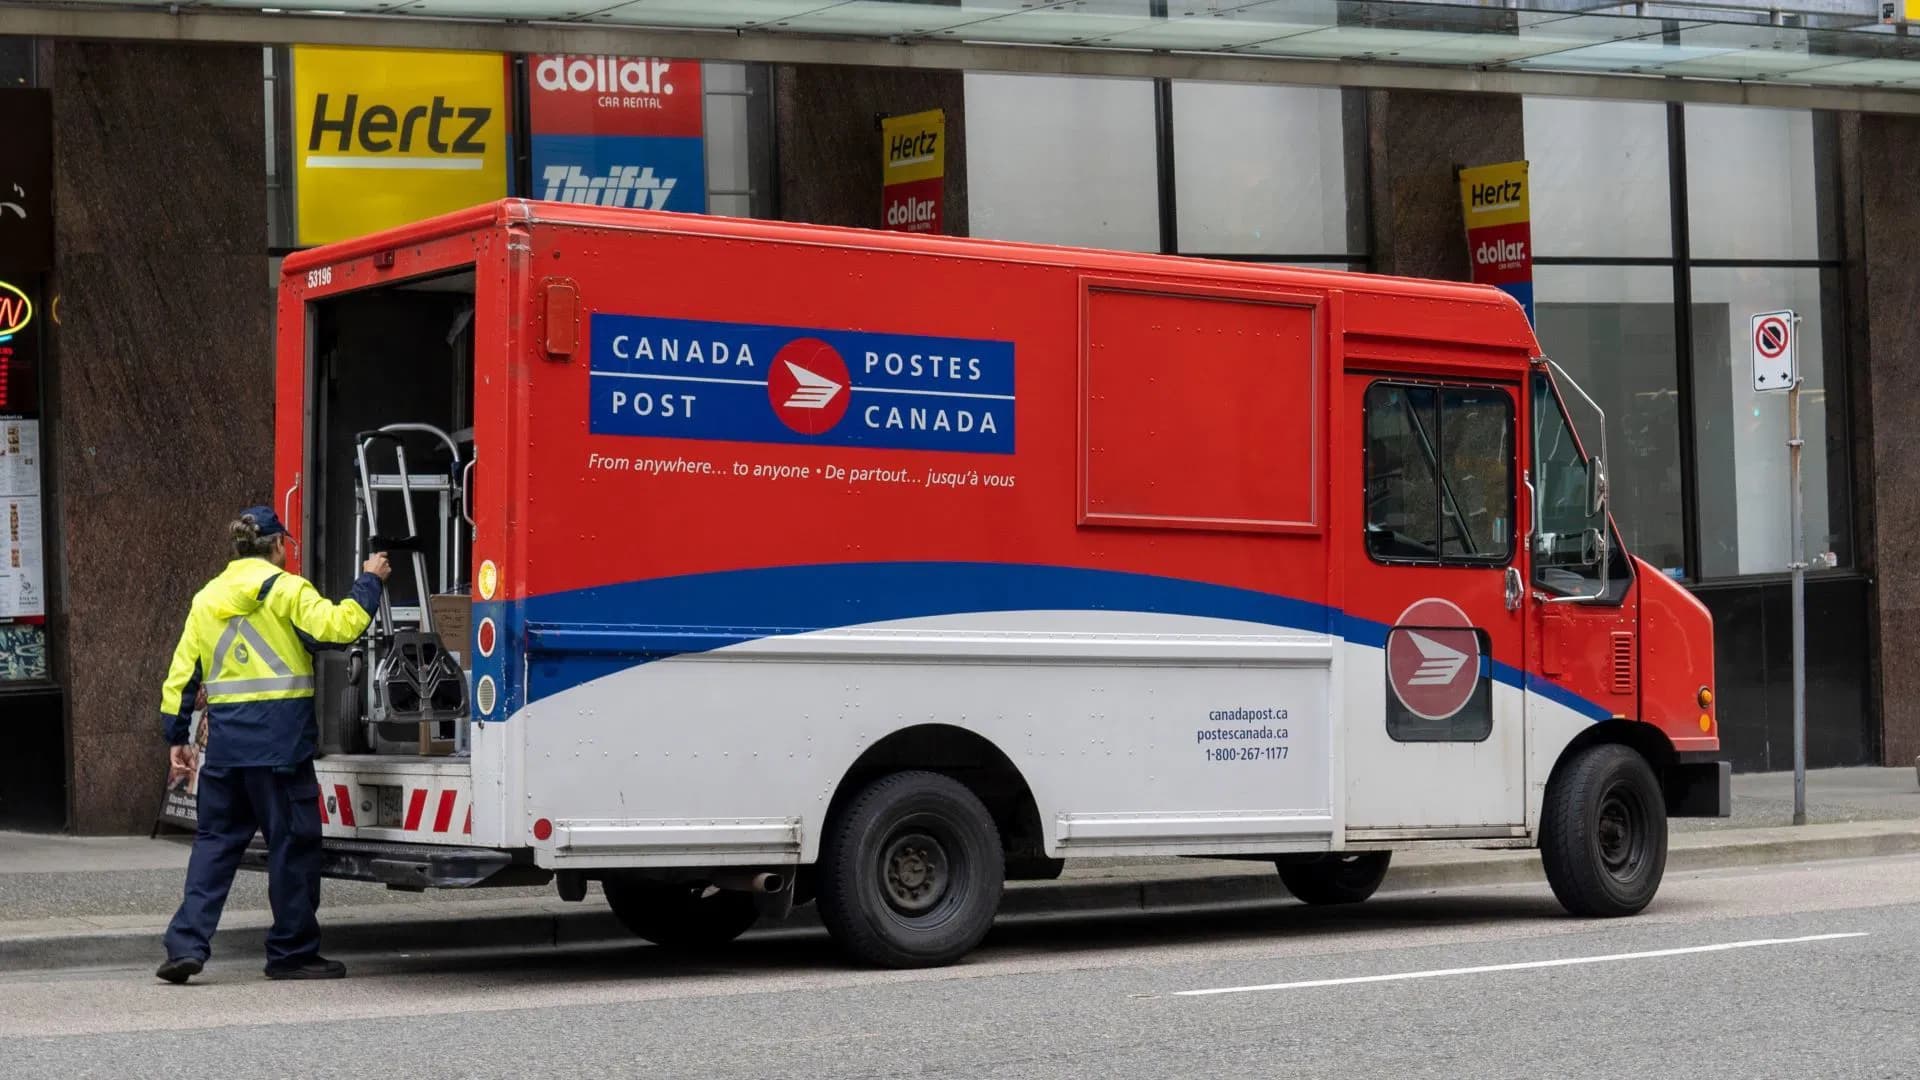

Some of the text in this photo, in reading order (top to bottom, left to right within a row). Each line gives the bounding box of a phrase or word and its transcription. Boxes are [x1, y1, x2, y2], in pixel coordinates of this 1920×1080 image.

[536, 54, 674, 95] dollar.
[598, 96, 662, 109] CAR RENTAL
[308, 93, 491, 153] Hertz
[890, 129, 937, 161] Hertz
[543, 166, 677, 211] Thrifty
[1471, 179, 1522, 207] Hertz
[887, 196, 936, 225] dollar.
[1476, 238, 1526, 265] dollar.
[308, 266, 332, 288] 53196
[612, 335, 754, 366] CANADA
[865, 351, 981, 381] POSTES
[612, 391, 696, 418] POST
[864, 405, 997, 434] CANADA
[588, 453, 629, 470] From
[634, 457, 727, 475] anywhere...
[733, 461, 749, 476] to
[753, 464, 810, 481] anyone
[824, 464, 846, 480] De
[849, 467, 921, 484] partout...
[983, 474, 1015, 487] vous
[1209, 706, 1288, 723] canadapost.ca
[1197, 725, 1288, 744] postescanada.ca
[1206, 746, 1289, 761] 1-800-267-1177
